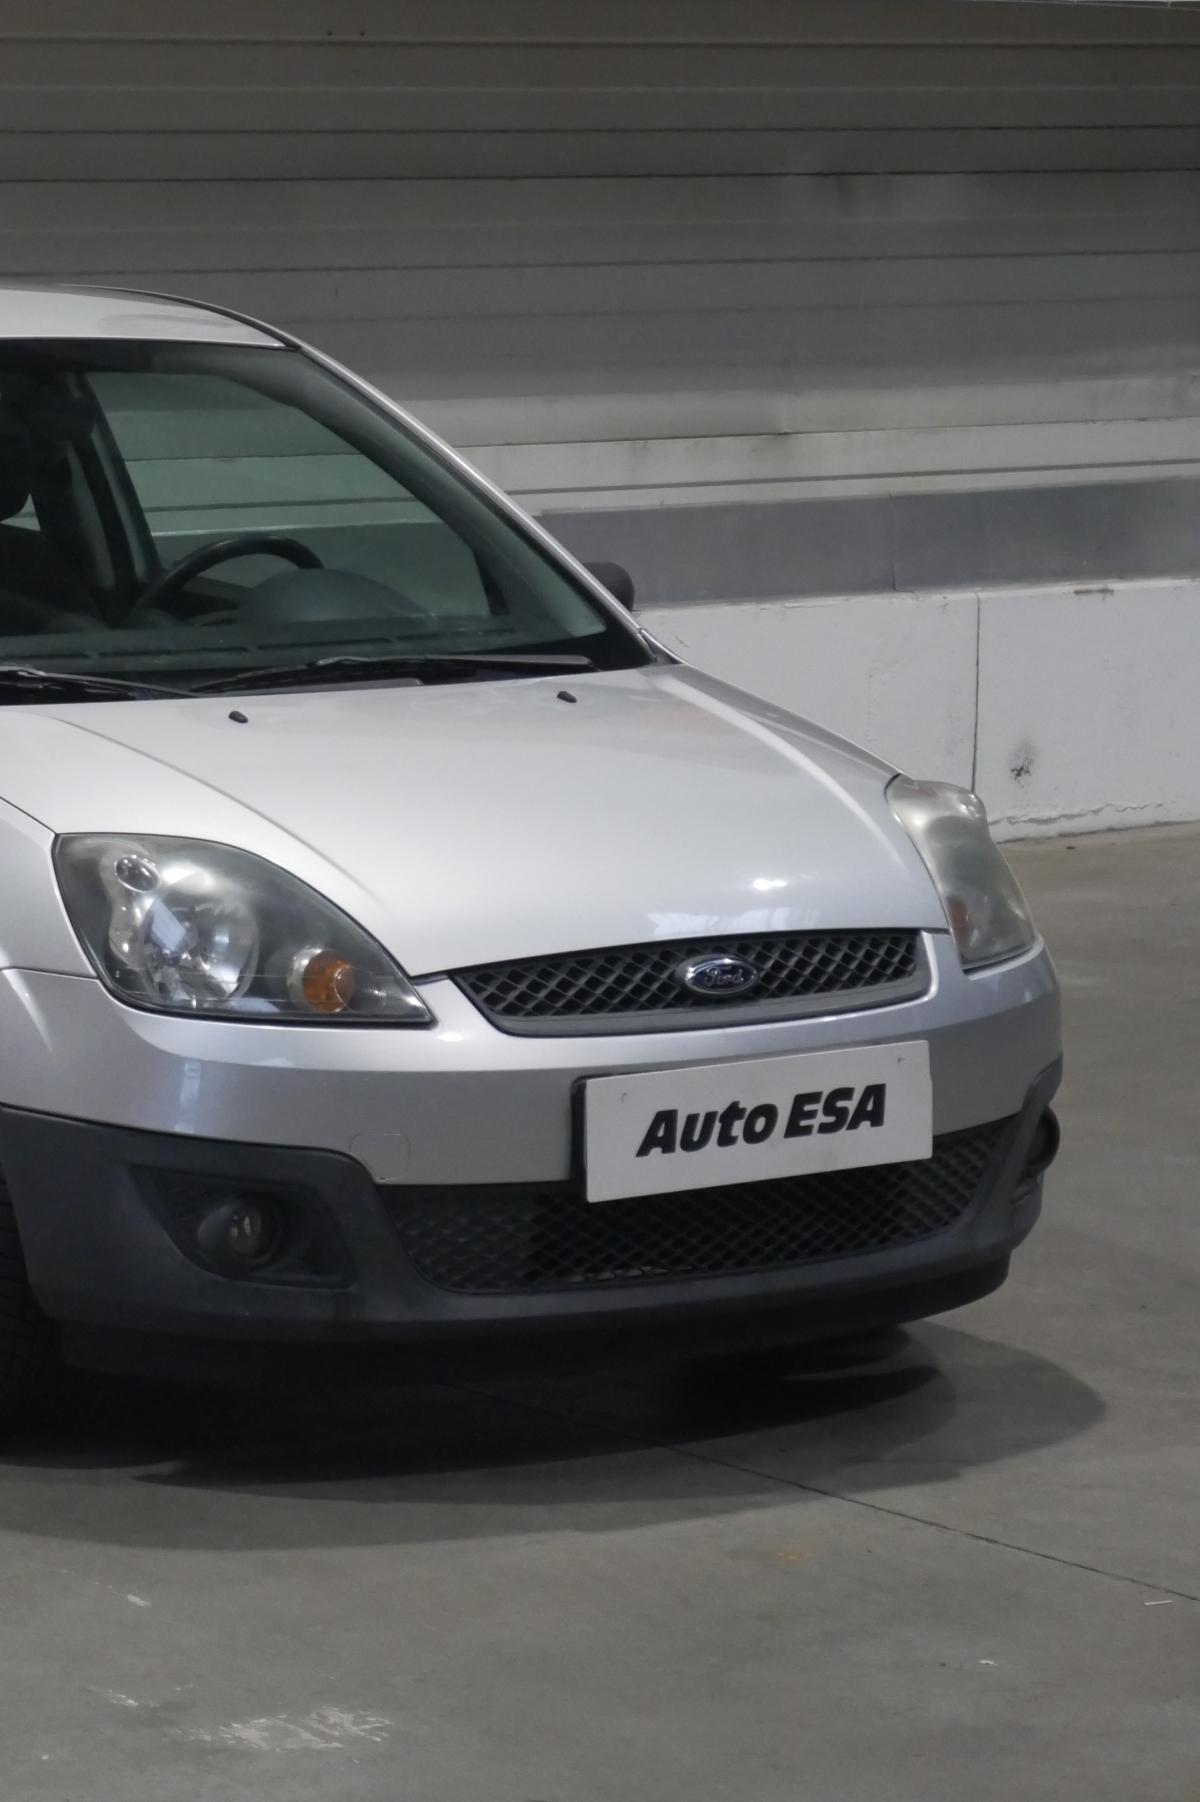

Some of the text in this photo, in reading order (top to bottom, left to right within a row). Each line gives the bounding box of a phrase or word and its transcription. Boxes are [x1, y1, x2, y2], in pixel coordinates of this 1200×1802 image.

[704, 965, 746, 987] Ford
[636, 1083, 886, 1158] Auto ESA
